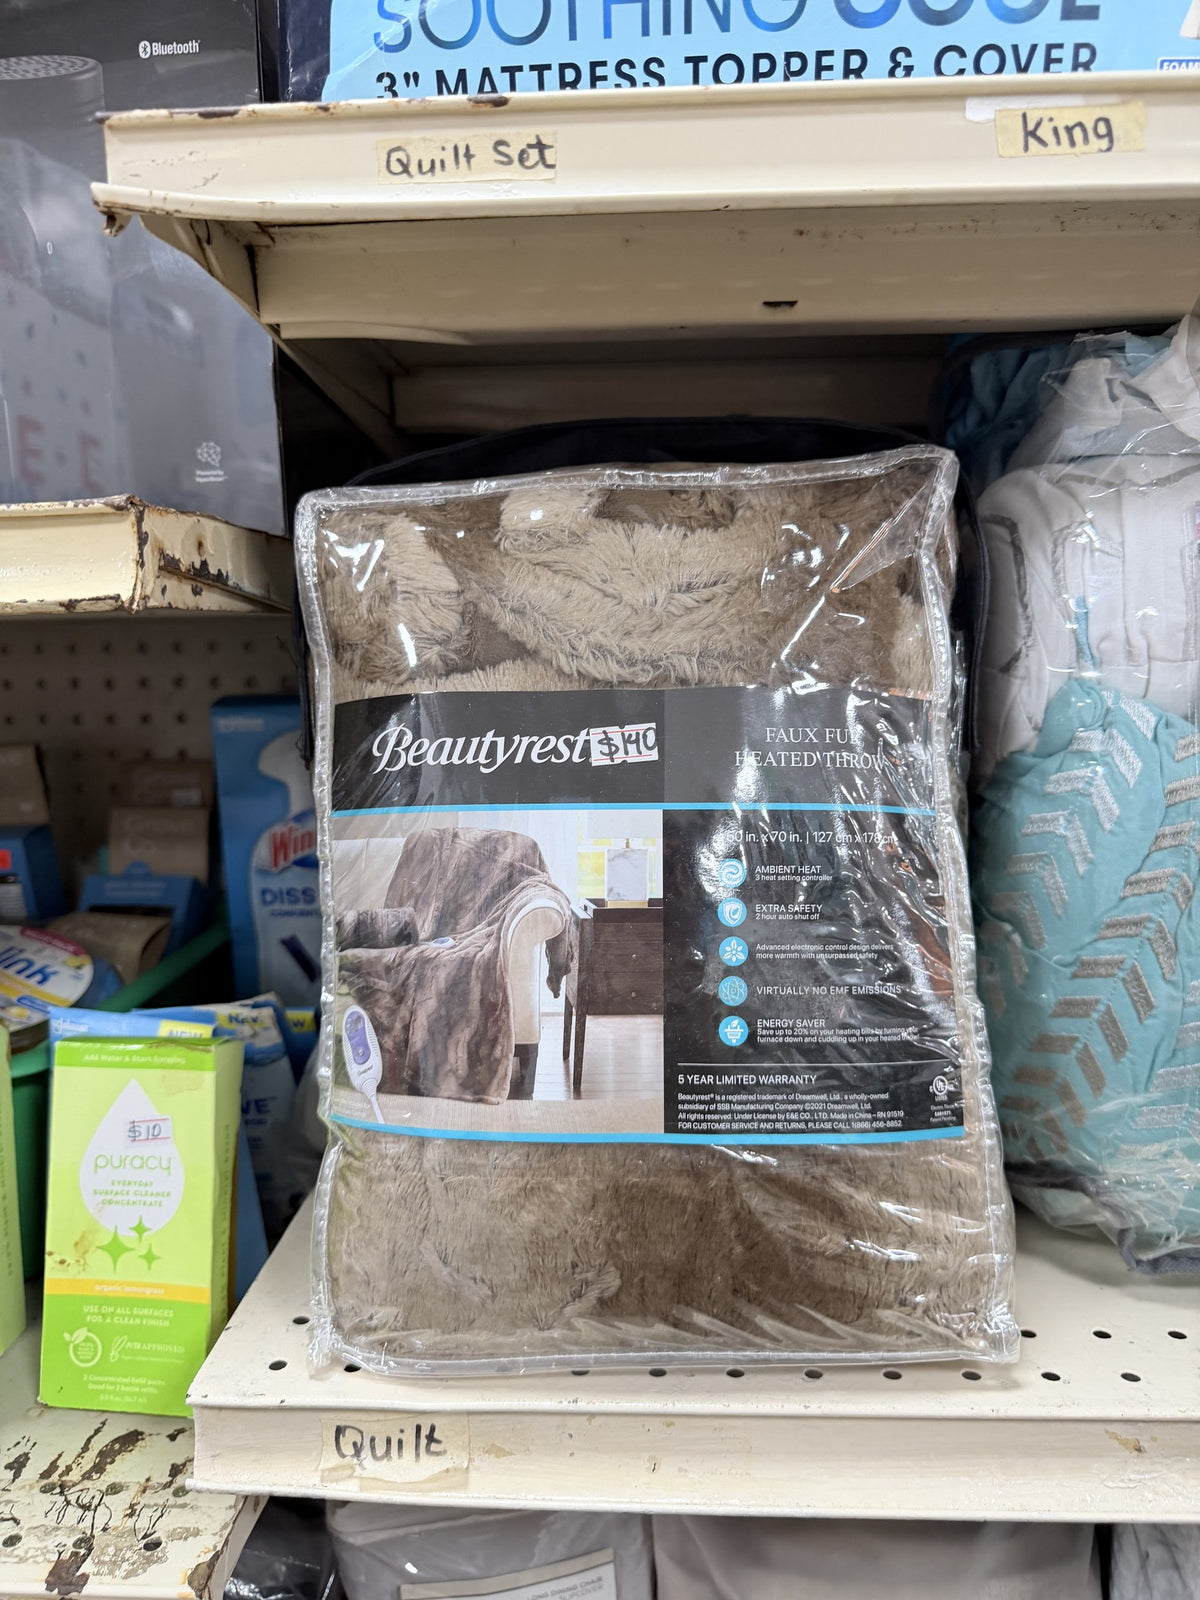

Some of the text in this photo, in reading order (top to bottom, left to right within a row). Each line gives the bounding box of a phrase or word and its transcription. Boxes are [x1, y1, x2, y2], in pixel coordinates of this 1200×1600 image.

[376, 42, 1098, 99] 3" MATTRESS TOPPER & COVER
[1021, 111, 1115, 153] King
[385, 133, 557, 179] Quilt Set
[764, 727, 819, 744] FAUX
[372, 723, 590, 774] Beautyrest
[599, 727, 658, 763] $140
[734, 750, 886, 772] HEATED THROW
[745, 831, 760, 844] in.
[771, 830, 787, 844] 70
[789, 831, 803, 844] in.
[812, 831, 833, 844] 127
[836, 833, 852, 844] cm
[863, 831, 881, 844] 178
[755, 865, 822, 874] AMBIENT HEAT
[777, 874, 802, 883] setting
[755, 904, 823, 913] EXTRA SAFETY
[849, 943, 870, 953] design
[870, 943, 894, 951] delivers
[803, 952, 816, 960] with
[816, 953, 858, 961] unsurpassed
[859, 952, 878, 961] safety
[756, 985, 902, 995] VIRTUALLY NO EMF EMISSIONS
[757, 1018, 826, 1028] ENERGY SAVER
[757, 1028, 774, 1036] Save
[775, 1029, 785, 1037] up
[785, 1028, 793, 1036] to
[793, 1028, 809, 1036] 20%
[819, 1029, 835, 1037] your
[835, 1028, 860, 1037] heating
[817, 1036, 848, 1044] cuddling
[864, 1036, 879, 1044] your
[879, 1034, 901, 1042] heated
[677, 1074, 817, 1085] 5 YEAR LIMITED WARRANTY
[726, 1093, 757, 1102] registered
[757, 1093, 788, 1101] trademark
[788, 1093, 795, 1101] of
[849, 1092, 889, 1101] wholly-owned
[677, 1103, 709, 1111] subsidiary
[709, 1103, 716, 1111] of
[716, 1103, 731, 1111] SSB
[731, 1102, 774, 1111] Manufacturing
[774, 1102, 804, 1111] Company
[804, 1102, 826, 1110] ©2021
[826, 1101, 860, 1110] Dreamwell,
[686, 1113, 704, 1121] rights
[733, 1112, 753, 1120] Under
[753, 1112, 777, 1120] License
[777, 1112, 786, 1121] by
[830, 1111, 849, 1119] Made
[854, 1111, 872, 1119] China
[677, 1121, 692, 1130] FOR
[692, 1121, 731, 1130] CUSTOMER
[731, 1121, 759, 1130] SERVICE
[759, 1121, 775, 1129] AND
[775, 1121, 807, 1130] RETURNS,
[808, 1121, 833, 1129] PLEASE
[833, 1121, 851, 1129] CALL
[127, 1120, 162, 1142] $10
[93, 1153, 172, 1176] puracy
[110, 1179, 154, 1188] EVERYDAY
[93, 1188, 171, 1198] SURFACE CLEANER
[83, 1305, 174, 1318] USE ON ALL SURFACES
[113, 1316, 140, 1326] CLEAN
[142, 1318, 170, 1328] FINISH
[334, 1422, 448, 1464] Quilt
